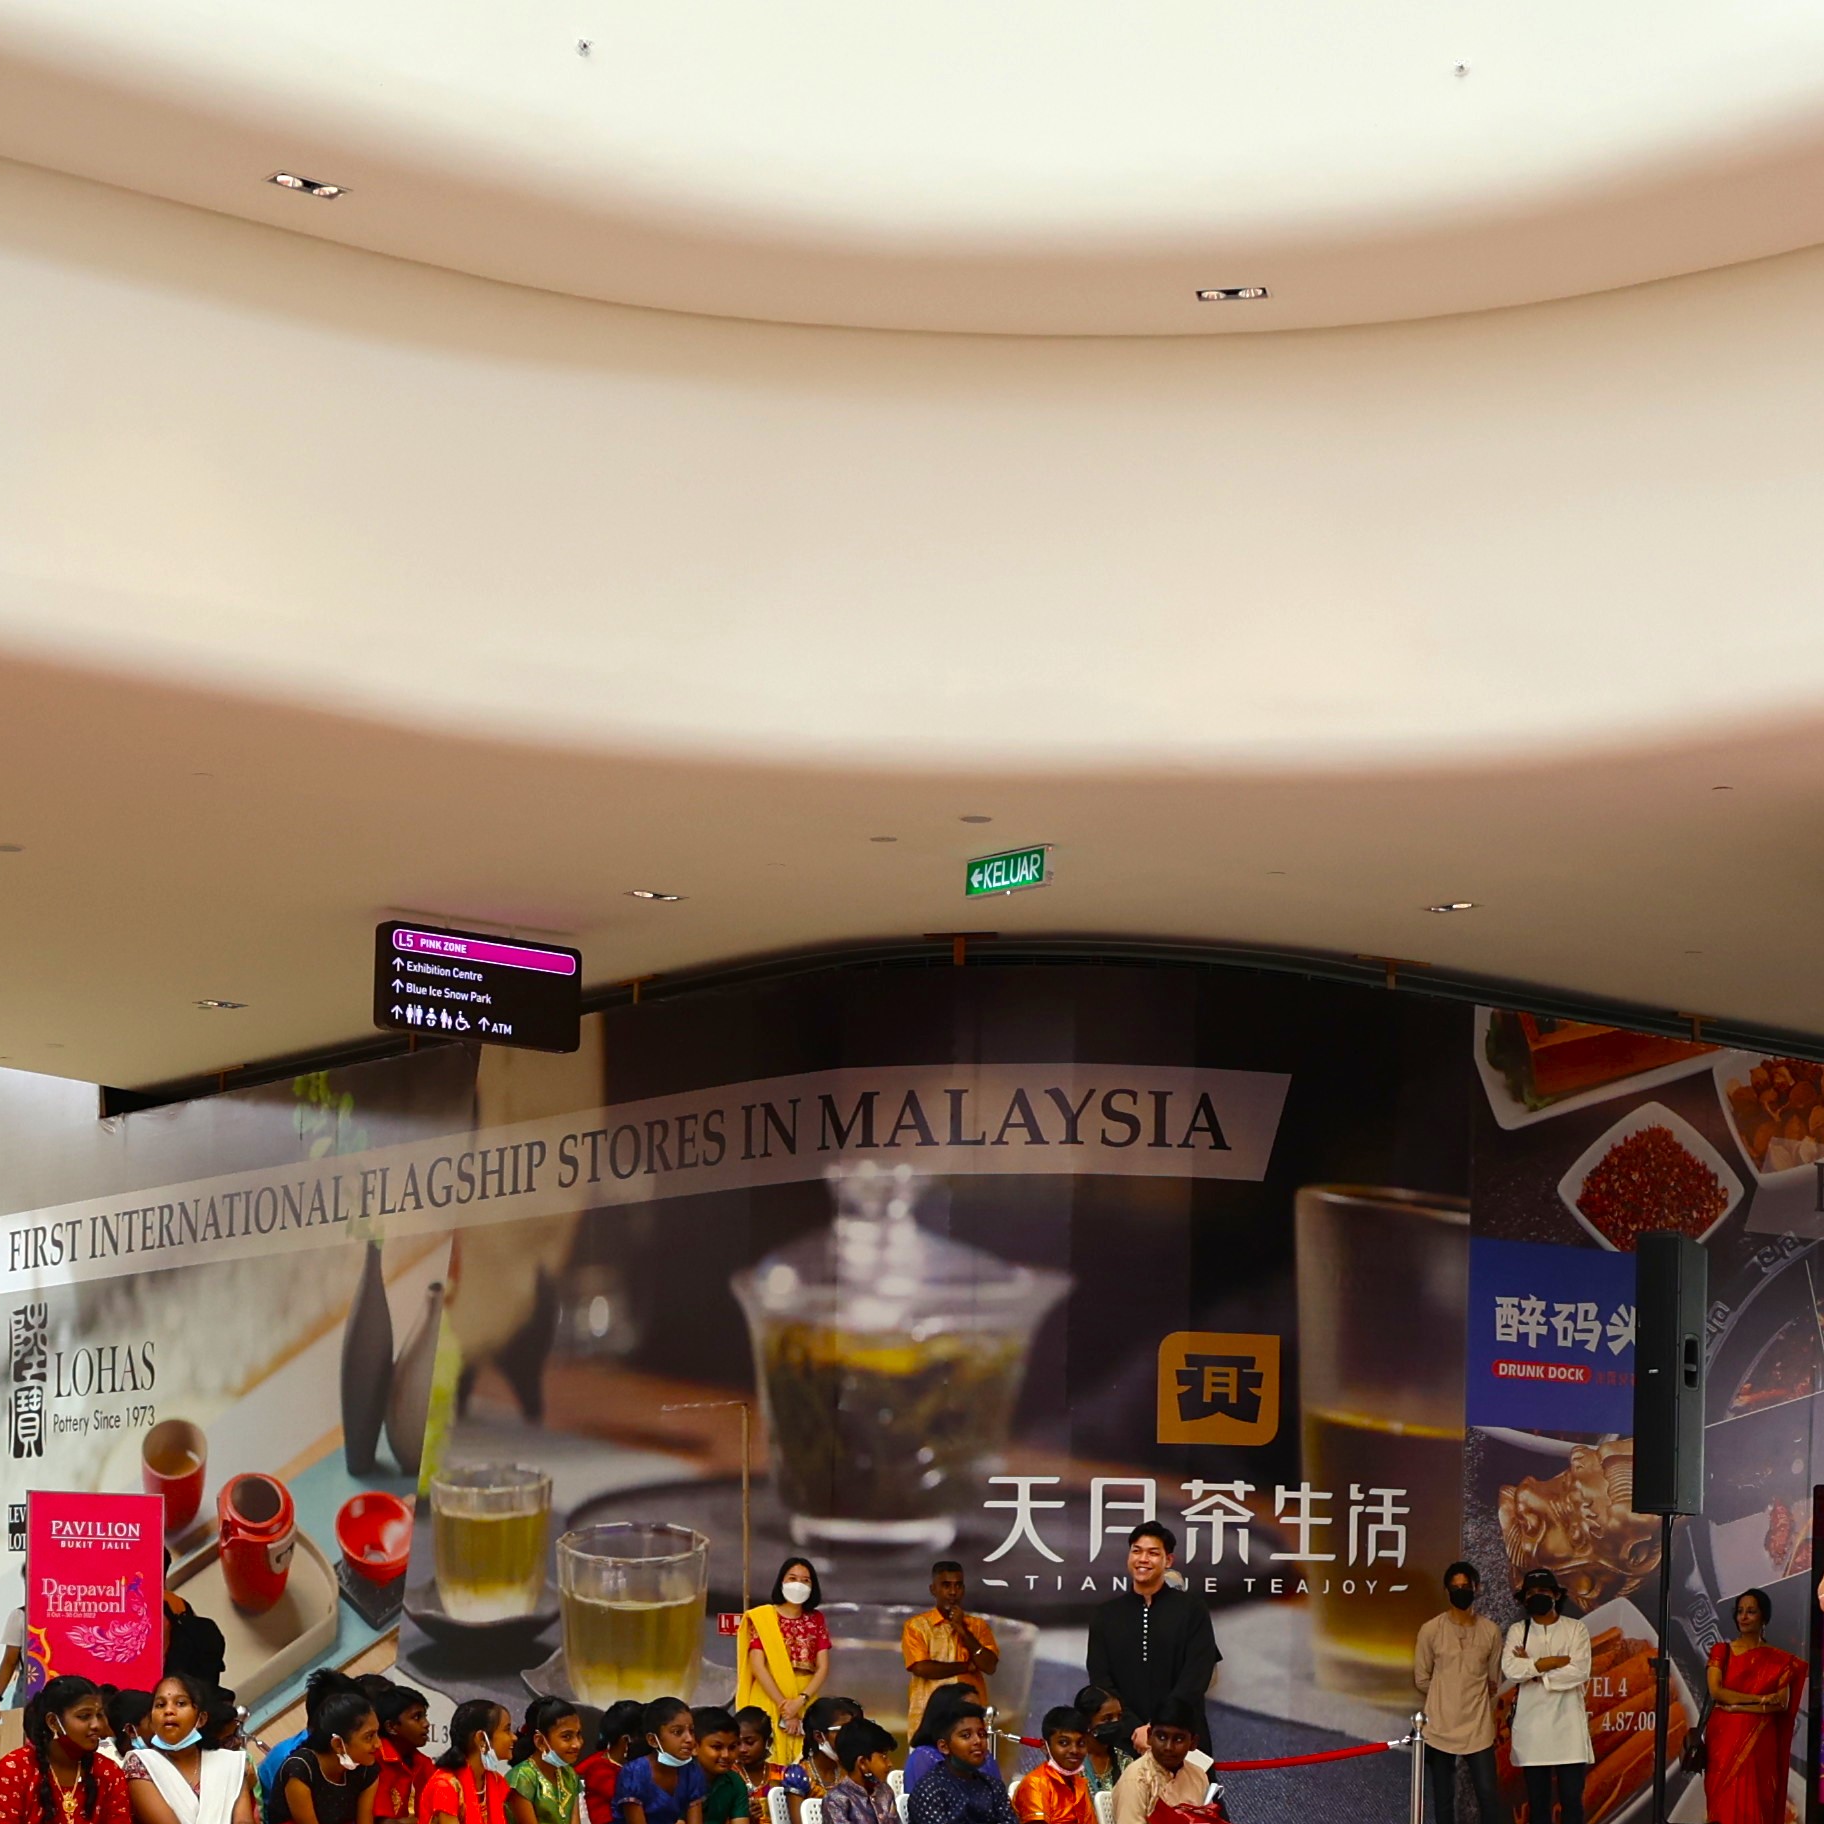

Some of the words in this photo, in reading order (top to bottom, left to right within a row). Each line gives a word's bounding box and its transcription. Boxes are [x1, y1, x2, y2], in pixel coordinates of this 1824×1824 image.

[982, 854, 1042, 889] KELUAR
[398, 935, 414, 948] L5
[420, 938, 442, 951] PINK
[443, 942, 467, 954] ZONE
[406, 960, 451, 978] Exhibition
[452, 967, 483, 982] Centre
[406, 983, 427, 996] Blue
[429, 986, 442, 998] Ice
[444, 988, 469, 1001] Snow
[470, 991, 492, 1005] Park
[491, 1022, 513, 1035] ATM
[9, 1219, 82, 1272] FIRST
[89, 1176, 350, 1260] INTERNATIONAL
[358, 1140, 548, 1220] FLAGSHIP
[557, 1108, 728, 1189] STORES
[740, 1098, 801, 1161] IN
[818, 1088, 1232, 1151] MALAYSIA
[54, 1340, 156, 1400] LOHAS
[1499, 1363, 1545, 1379] DRUNK
[1548, 1365, 1584, 1381] DOCK
[53, 1411, 90, 1436] Pottery
[93, 1408, 122, 1431] Since
[125, 1405, 156, 1428] 1973
[51, 1520, 140, 1537] PAVILION
[60, 1540, 94, 1549] BUKIT
[102, 1542, 131, 1550] JALIL
[1025, 1574, 1217, 1593] TIANE
[1243, 1576, 1379, 1595] TEAJOY
[1618, 1677, 1628, 1697] 4
